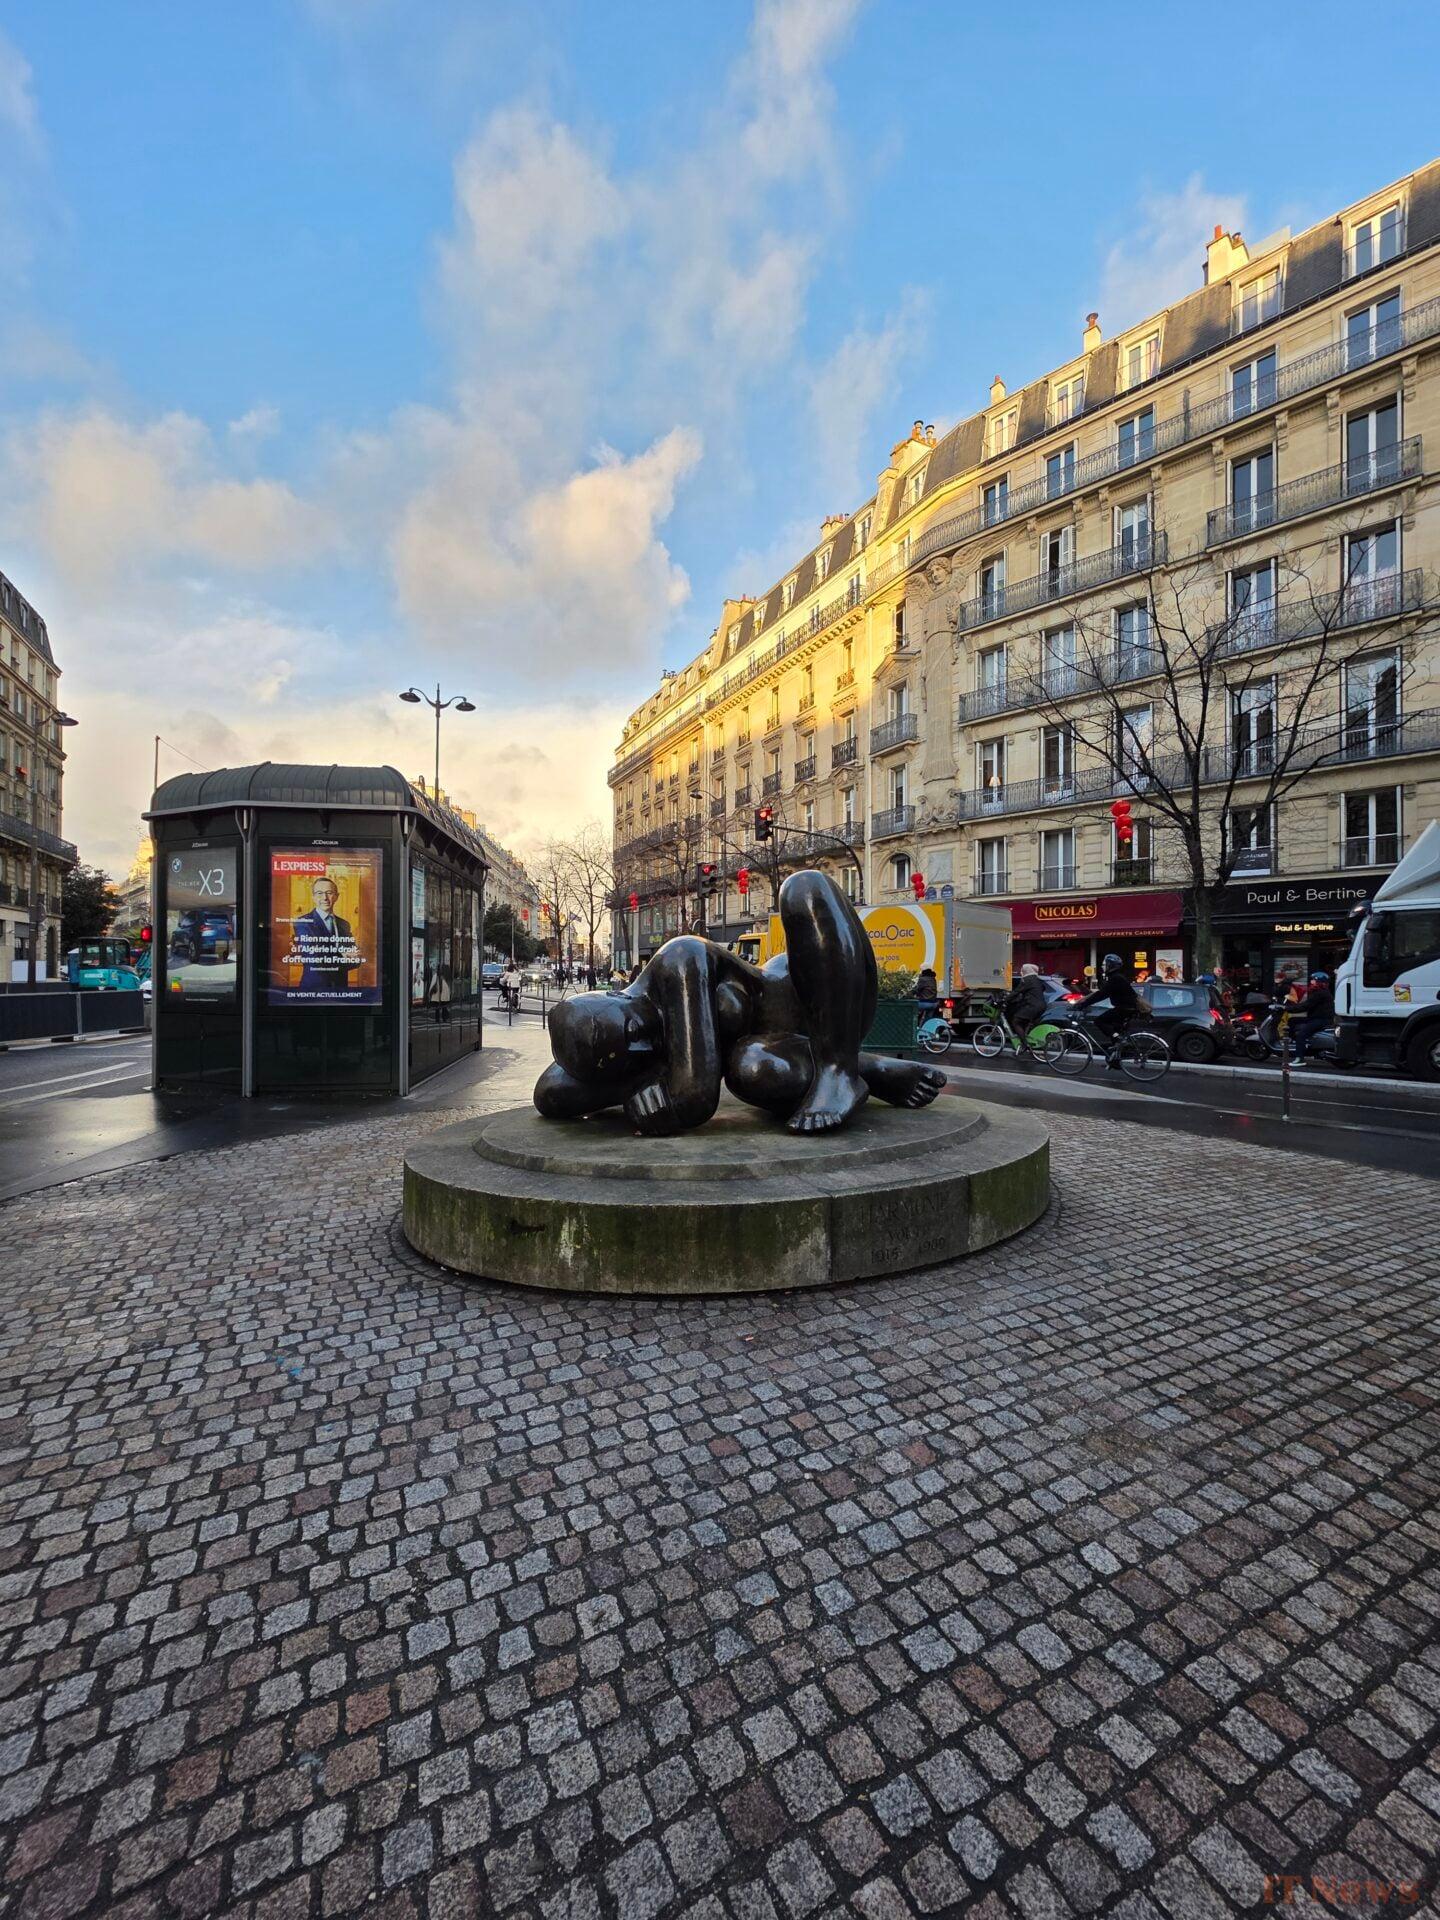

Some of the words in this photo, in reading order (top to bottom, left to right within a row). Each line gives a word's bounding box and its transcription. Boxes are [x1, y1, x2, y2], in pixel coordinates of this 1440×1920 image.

[198, 869, 224, 896] X3
[1247, 891, 1280, 904] Paul
[1286, 889, 1300, 901] &
[1306, 887, 1367, 900] Bertine
[1039, 905, 1093, 917] NICOLAS
[1275, 924, 1293, 932] Paul
[1303, 923, 1334, 931] Bertine
[300, 934, 318, 942] Rien
[291, 944, 297, 953] à
[297, 944, 330, 954] l'Algérie
[330, 945, 338, 953] le
[338, 945, 358, 953] droit
[282, 954, 323, 963] d'offenser
[324, 955, 332, 963] la
[332, 956, 360, 964] France
